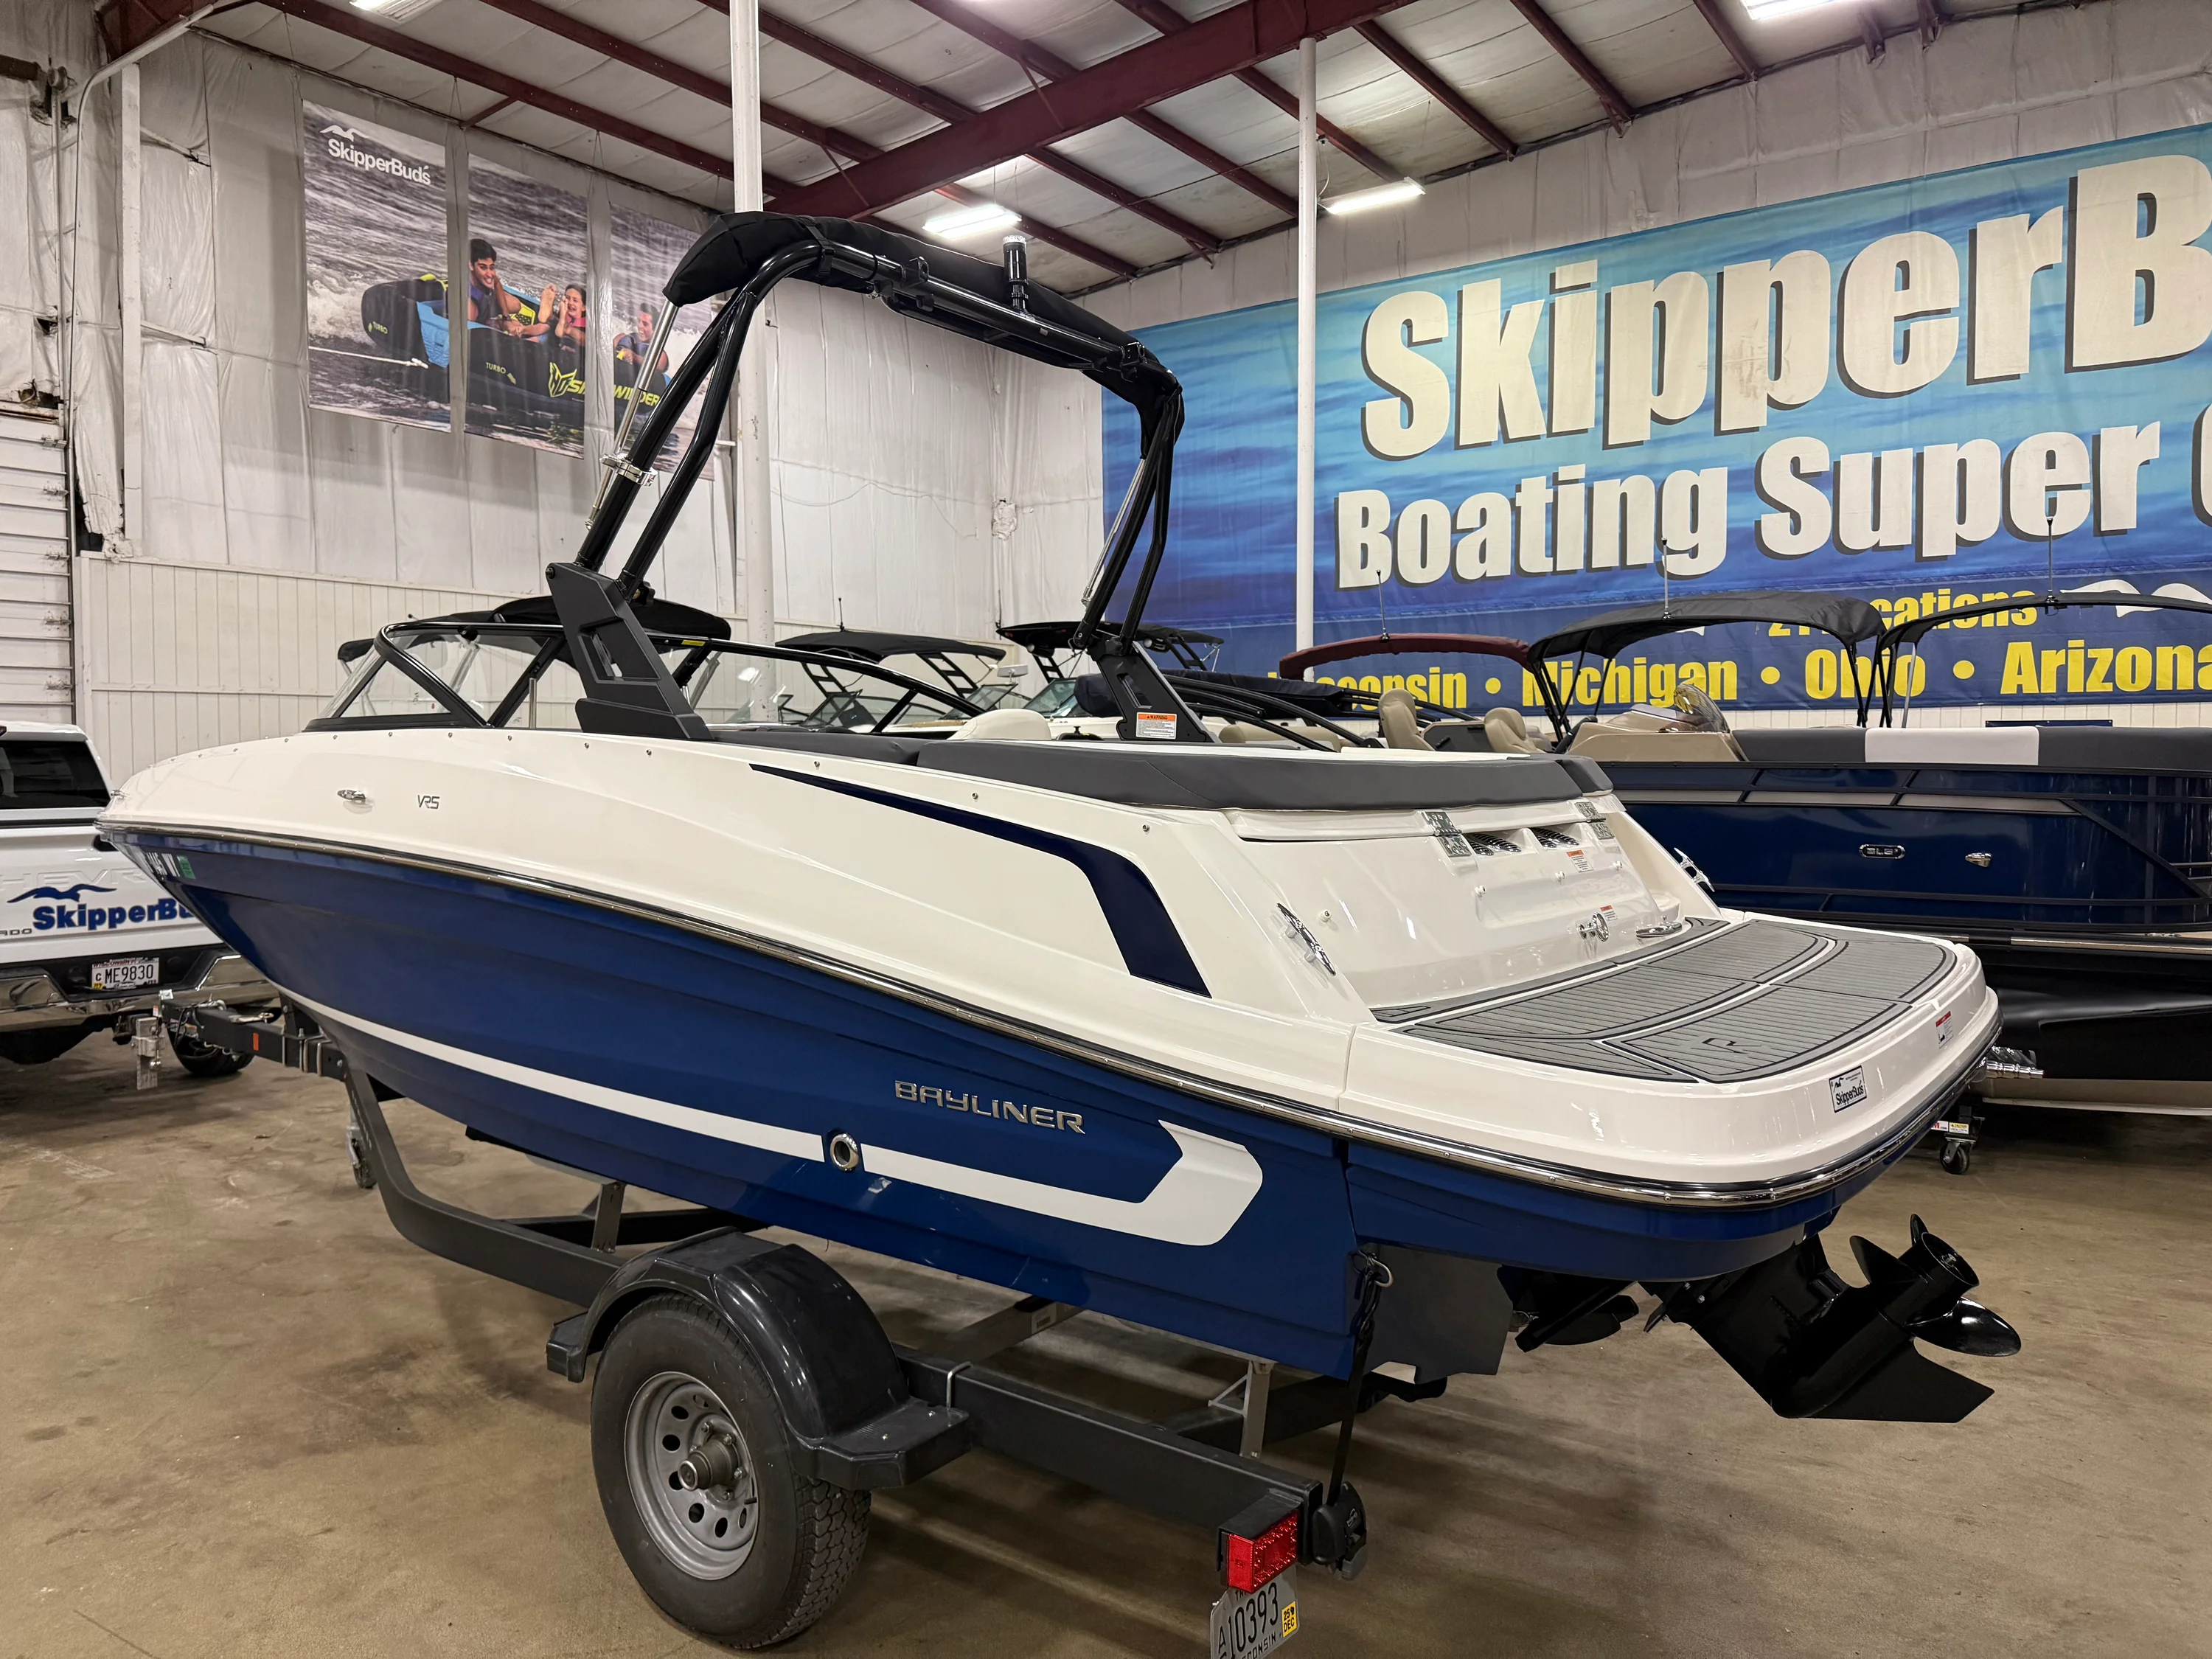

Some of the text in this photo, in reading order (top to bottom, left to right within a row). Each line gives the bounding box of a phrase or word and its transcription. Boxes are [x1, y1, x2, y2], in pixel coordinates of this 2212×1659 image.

[485, 361, 507, 375] TURBO
[1335, 463, 1728, 590] Boating
[1754, 421, 2161, 563] Super
[105, 964, 154, 984] ME9830
[894, 1079, 1086, 1135] BAYLINER
[1283, 1617, 1295, 1632] DEC
